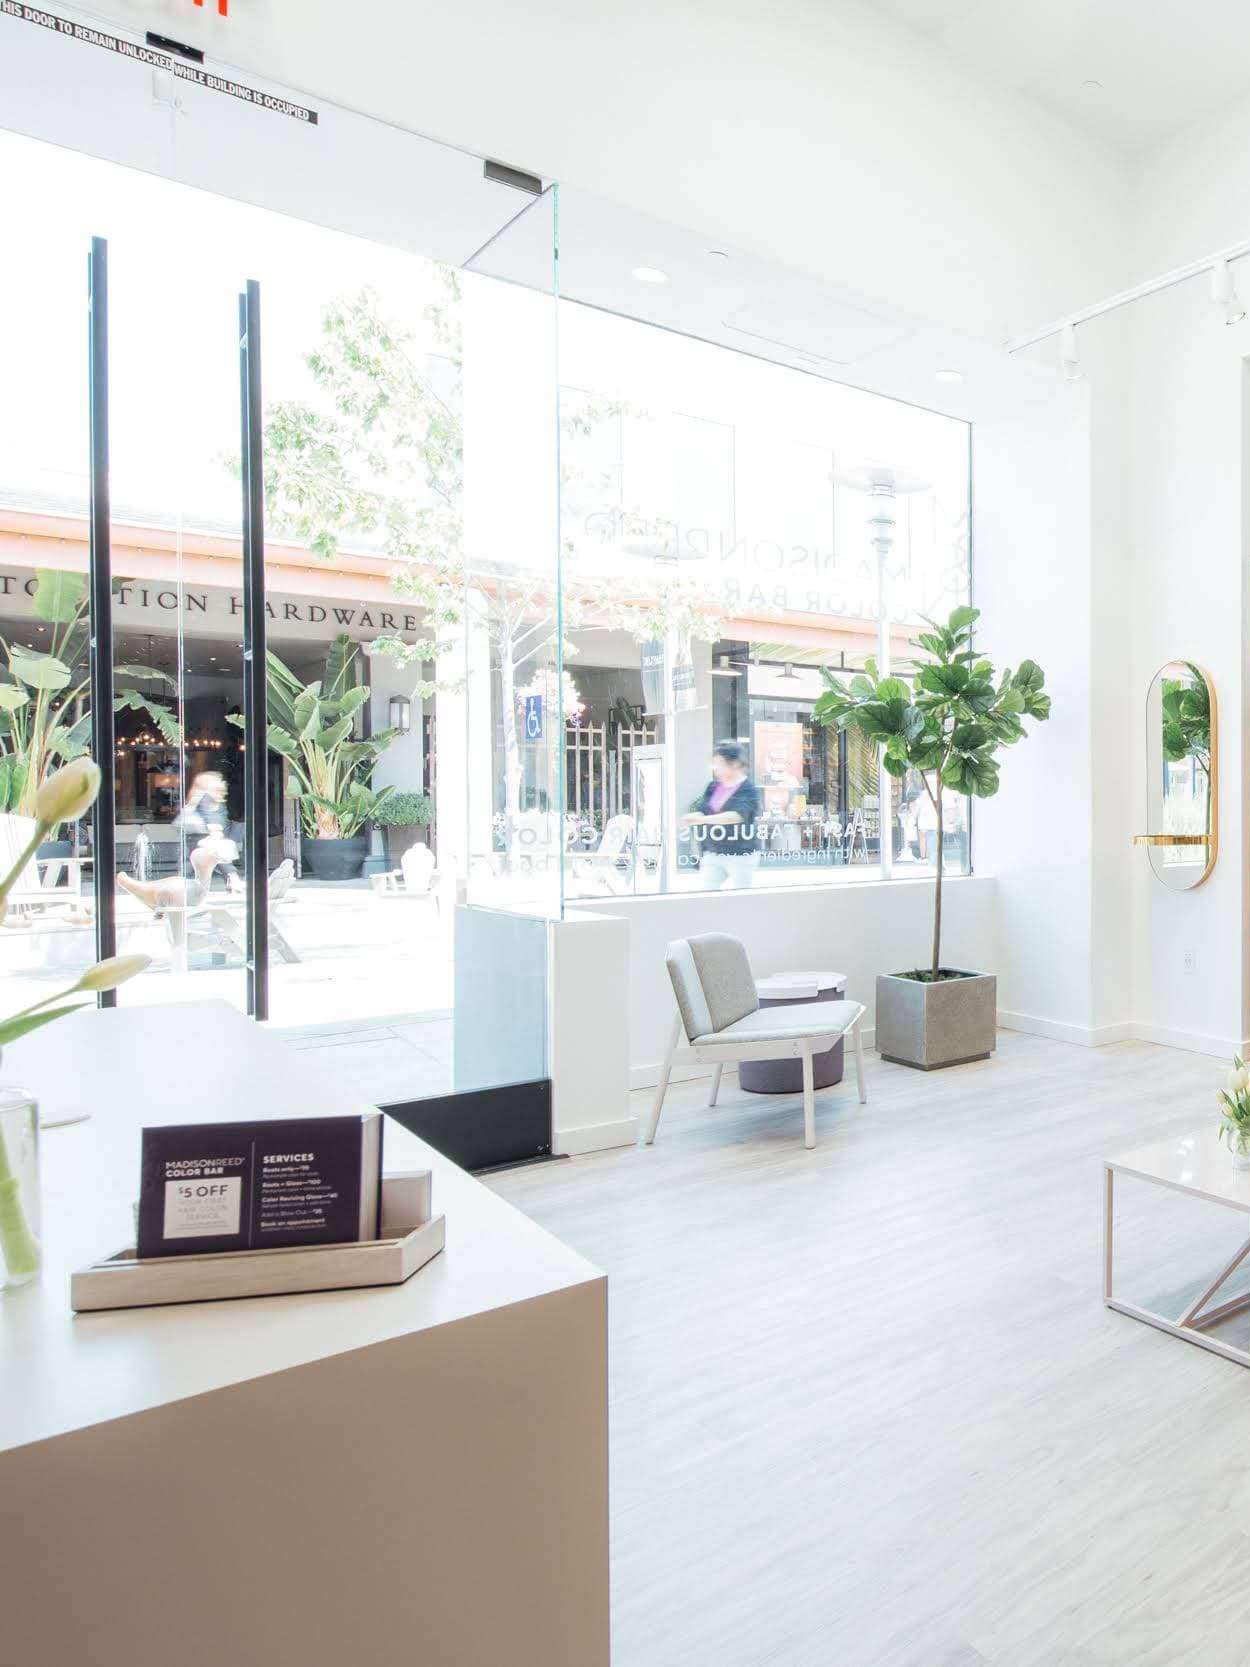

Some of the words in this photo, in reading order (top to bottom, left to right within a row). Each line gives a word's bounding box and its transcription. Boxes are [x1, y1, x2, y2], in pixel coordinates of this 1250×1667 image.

[0, 0, 22, 17] HIS
[24, 7, 57, 28] DOOR
[58, 19, 73, 34] TO
[74, 26, 117, 50] REMAIN
[118, 41, 173, 71] UNLOCKED
[174, 63, 206, 85] WHILE
[207, 74, 251, 100] BUILDING
[253, 91, 263, 105] IS
[264, 95, 310, 121] OCCUPIED
[263, 1152, 315, 1164] SERVICES
[165, 1168, 201, 1177] COLOR
[203, 1167, 224, 1175] BAR
[196, 1184, 229, 1197] OFF
